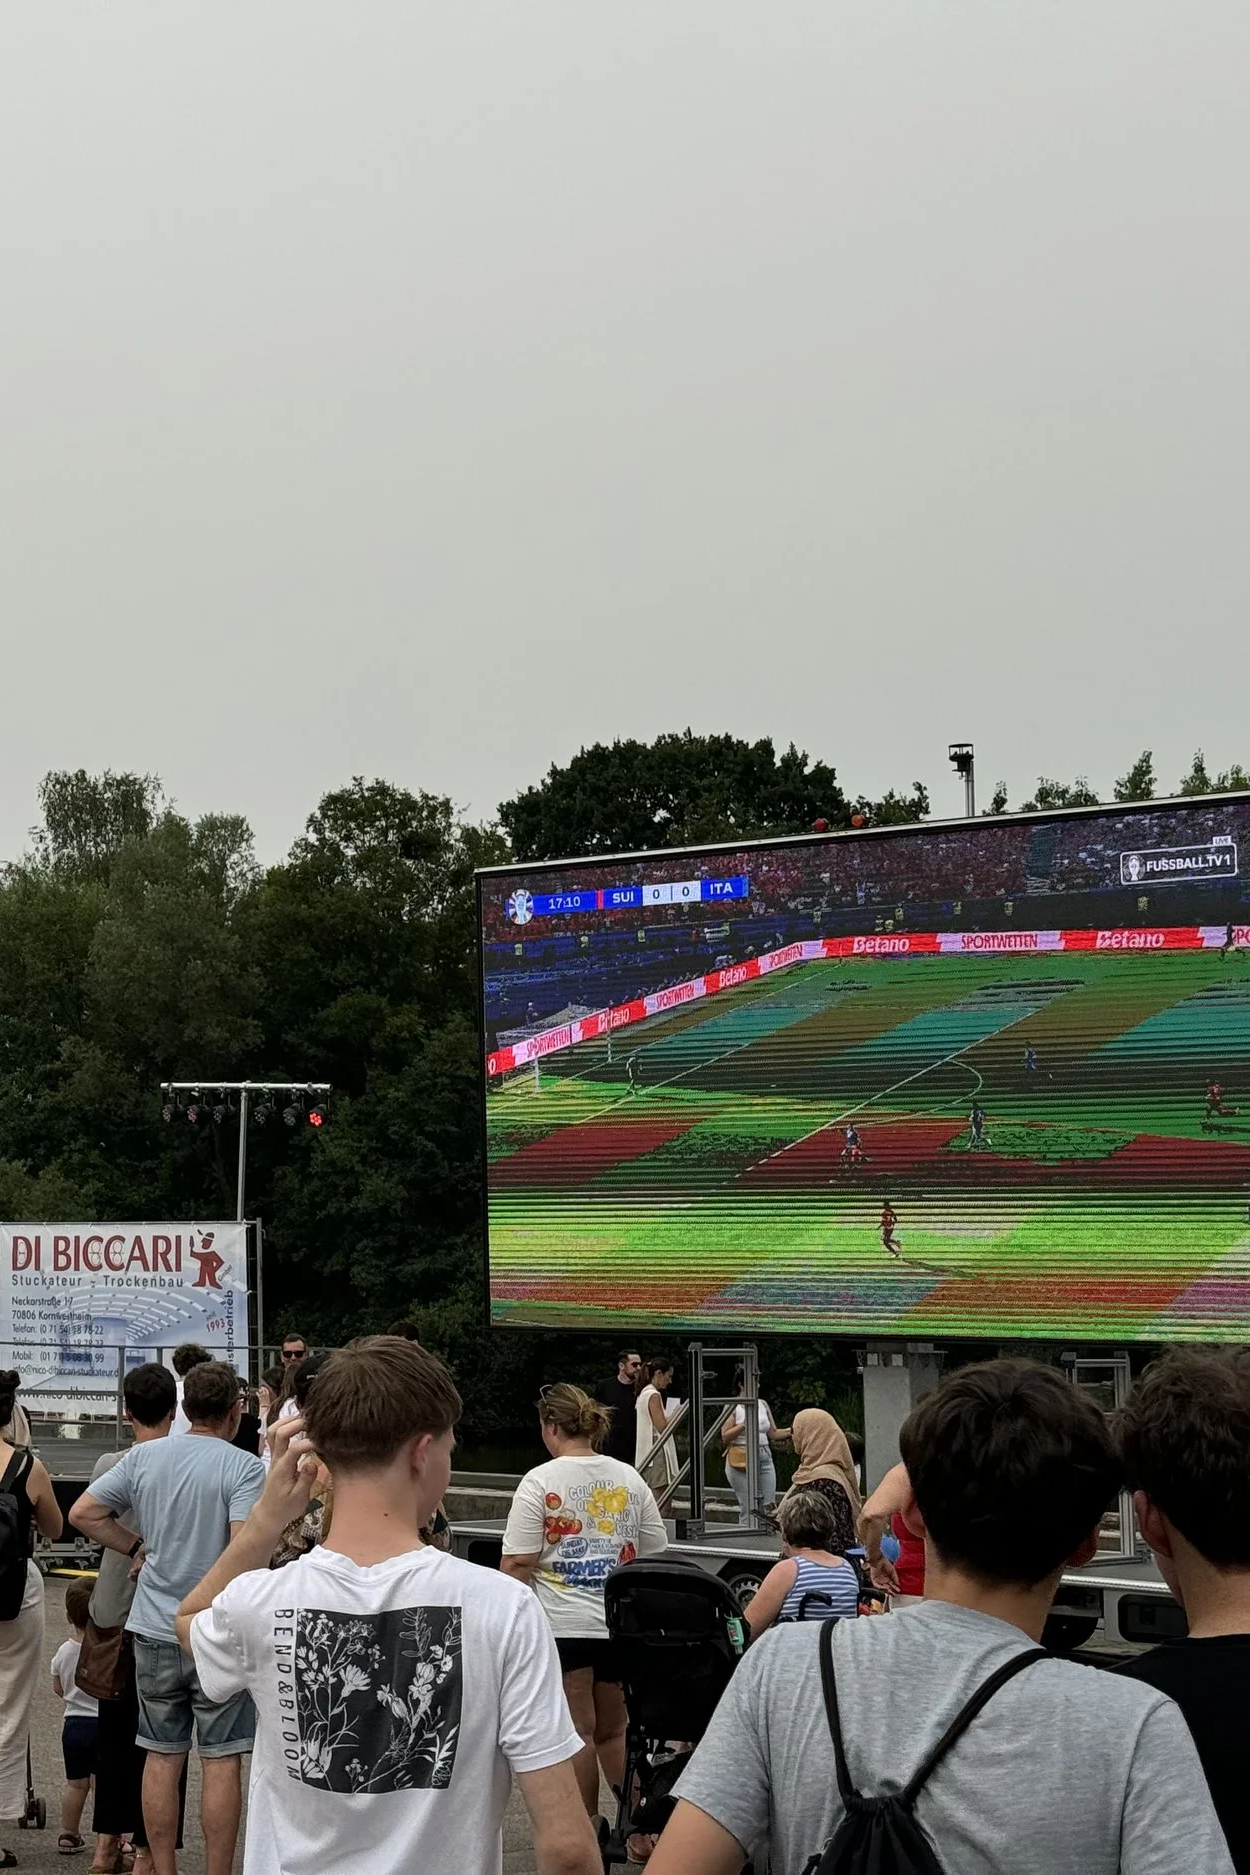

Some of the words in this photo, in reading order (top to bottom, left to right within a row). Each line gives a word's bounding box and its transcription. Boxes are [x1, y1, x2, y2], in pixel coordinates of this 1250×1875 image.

[548, 896, 581, 910] 17:10
[612, 891, 634, 904] SUI
[652, 889, 660, 900] 0
[681, 886, 690, 897] 0
[709, 882, 733, 895] ITA
[852, 936, 910, 953] Betano
[961, 933, 1038, 950] SPORTWETTEN
[1096, 930, 1165, 949] Betano
[719, 967, 747, 988] Betano
[12, 1235, 41, 1272] DI
[53, 1234, 182, 1272] BICCARI
[11, 1274, 82, 1288] Stuckateur
[103, 1274, 184, 1288] Trockenbau
[11, 1296, 61, 1307] Neckarstraße
[11, 1310, 36, 1320] 70806
[38, 1310, 92, 1321] Kornwestheim
[206, 1318, 226, 1333] 1993
[225, 1289, 235, 1362] isterbetrieb
